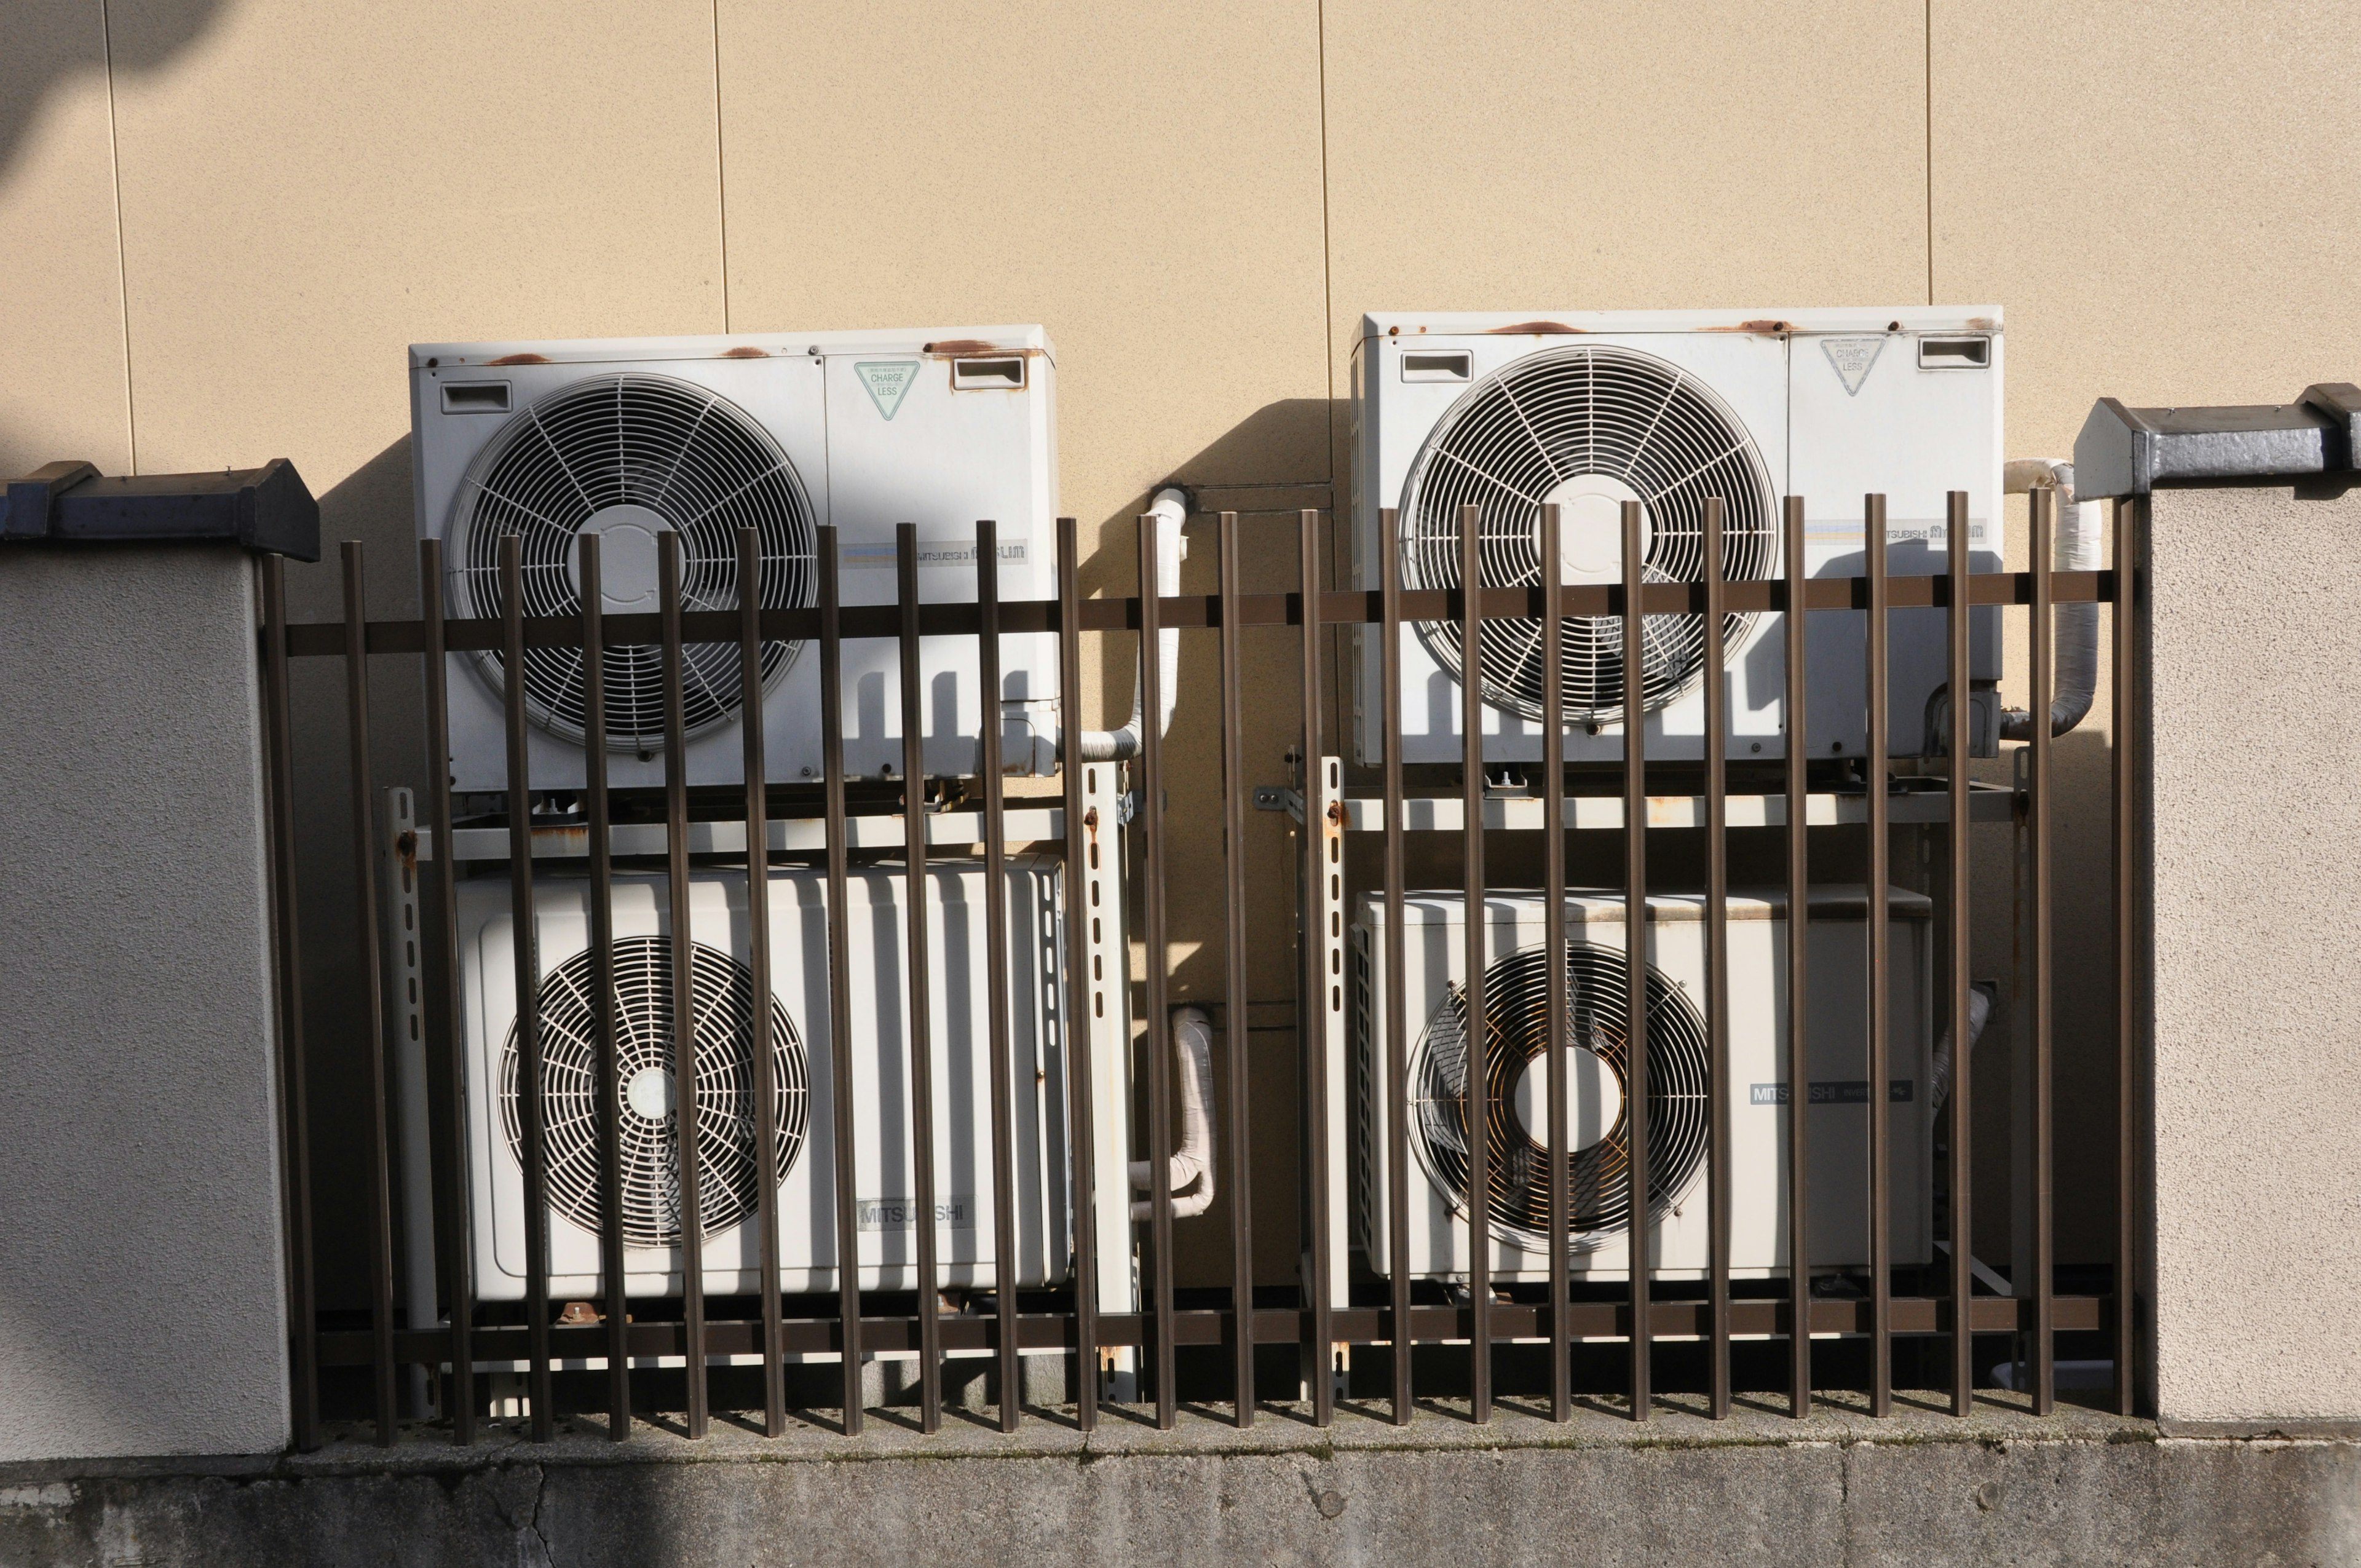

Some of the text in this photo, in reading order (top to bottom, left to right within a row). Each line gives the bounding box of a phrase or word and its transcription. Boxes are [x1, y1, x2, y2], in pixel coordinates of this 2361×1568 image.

[1837, 349, 1869, 357] CHARGE
[1843, 362, 1863, 371] LESS
[871, 373, 903, 382] CHARGE
[877, 387, 898, 395] LESS
[1886, 530, 1928, 539] TSUBISHI
[1754, 1087, 1835, 1101] MITSISHI
[861, 1205, 963, 1223] MITSUSHI
